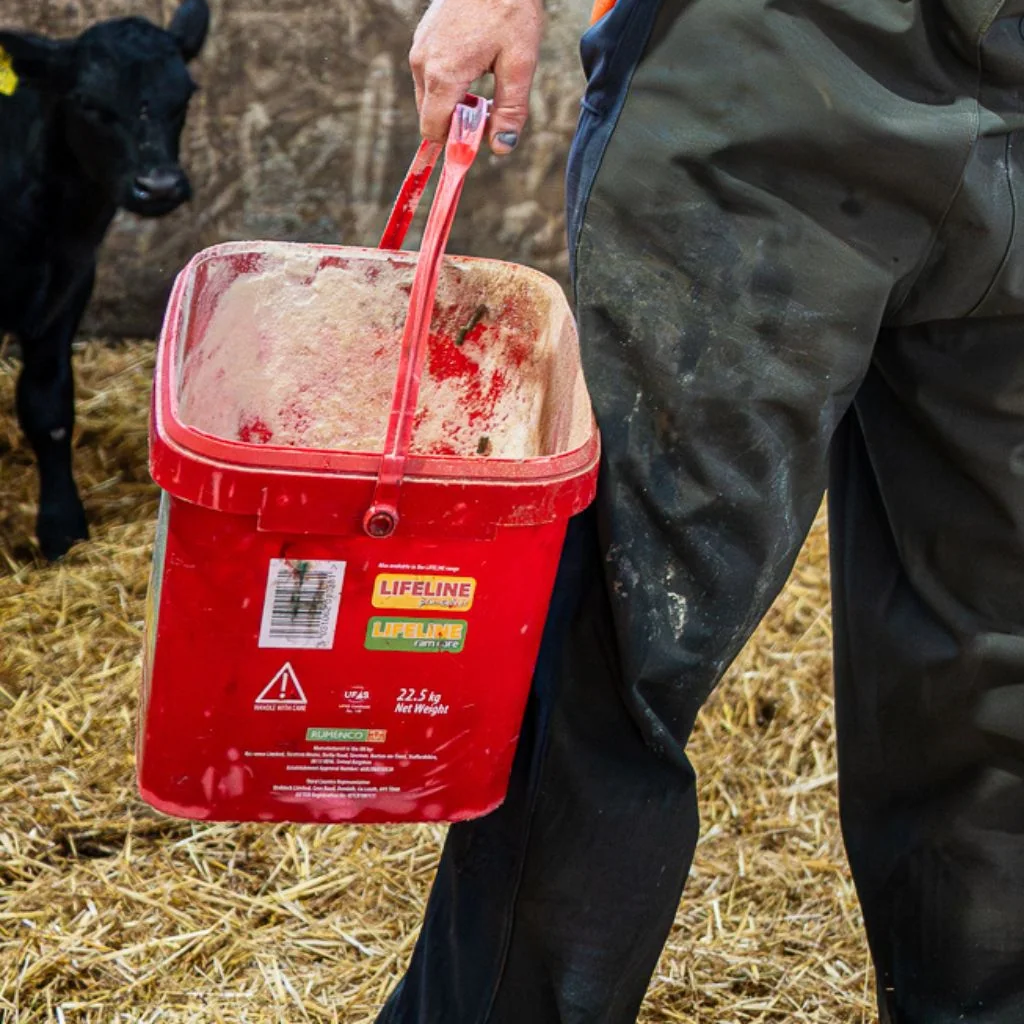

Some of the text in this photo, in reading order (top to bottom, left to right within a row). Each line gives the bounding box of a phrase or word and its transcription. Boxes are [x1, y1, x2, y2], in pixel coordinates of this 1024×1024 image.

[379, 579, 471, 597] LIFELINE
[372, 622, 463, 639] LIFELINE
[414, 640, 435, 649] ram
[396, 688, 442, 704] 22.5 kg
[394, 702, 449, 717] Net Weight
